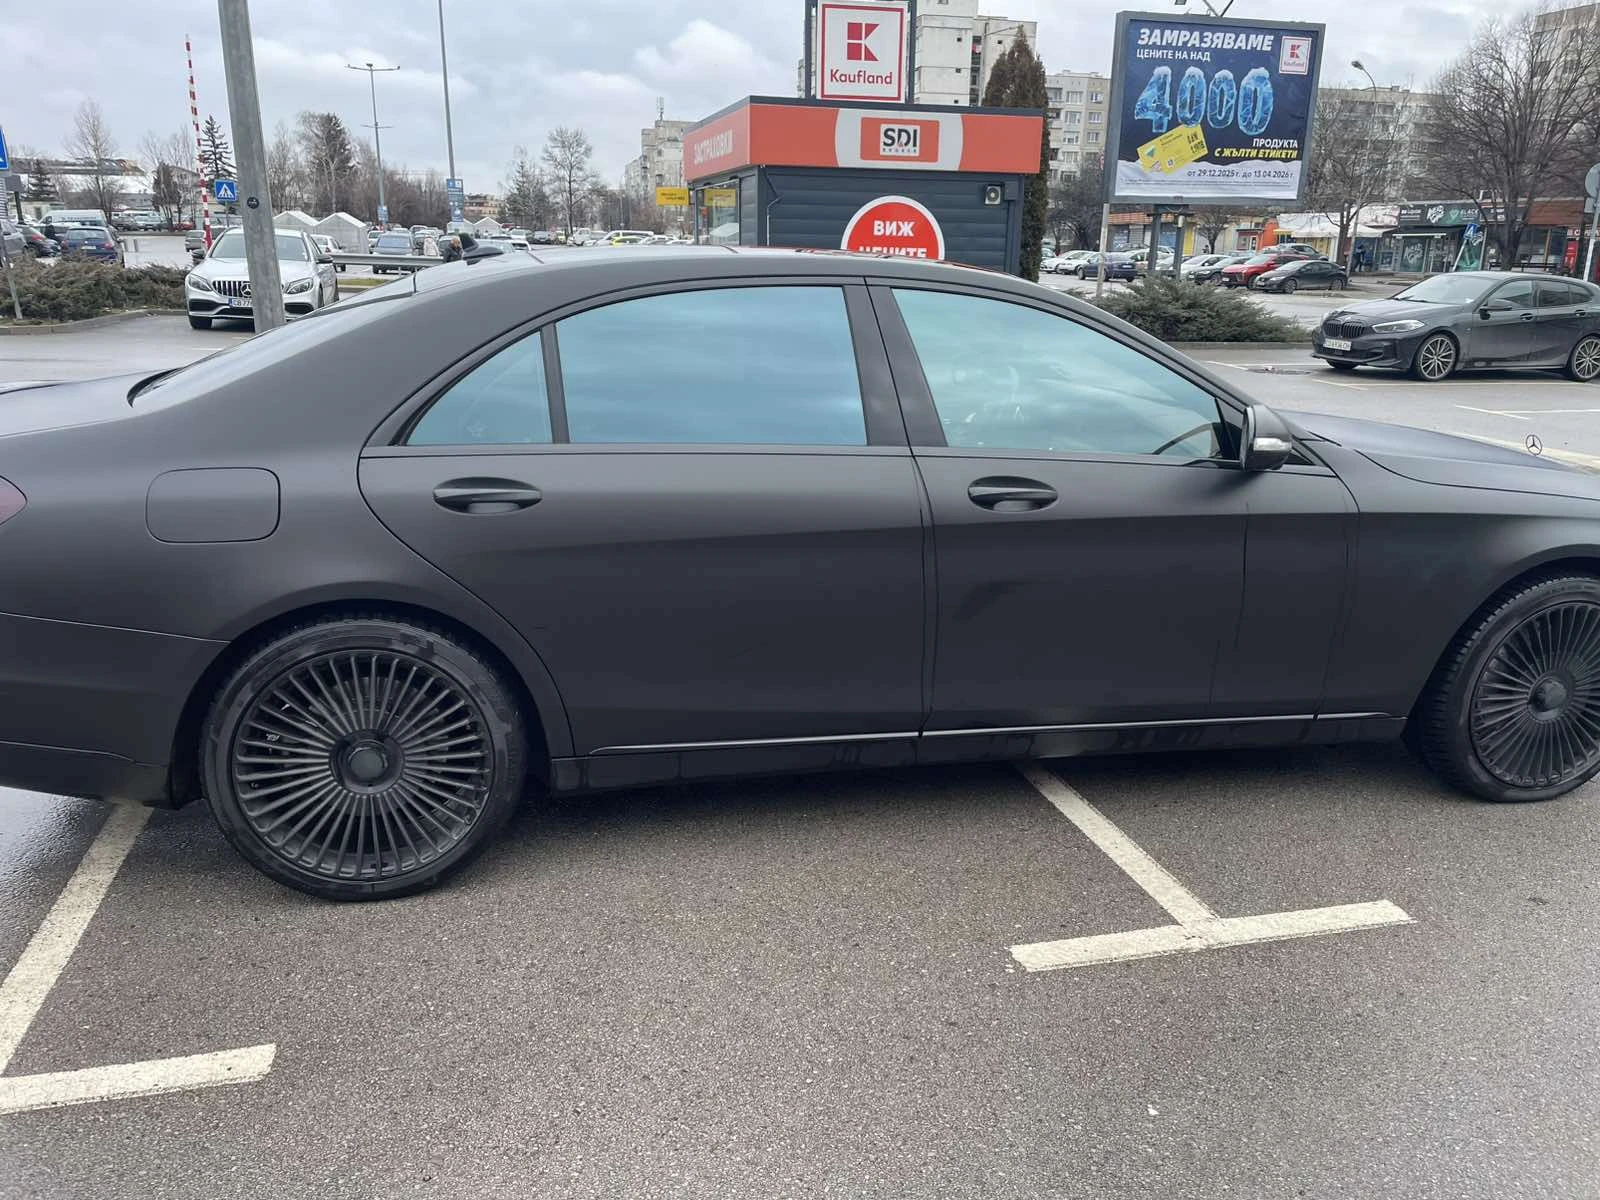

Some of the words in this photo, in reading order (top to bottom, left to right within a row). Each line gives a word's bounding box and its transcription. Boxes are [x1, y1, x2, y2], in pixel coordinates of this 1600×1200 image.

[1138, 28, 1274, 51] ЗАМРАЗЯВАМЕ
[1136, 49, 1173, 60] ЦЕНИТЕ
[1175, 50, 1188, 59] НА
[1190, 51, 1211, 62] НАД
[830, 69, 893, 85] Kaufland
[1134, 65, 1274, 136] 4000
[883, 127, 918, 148] SDI
[1253, 138, 1298, 149] ПРОДУКТА
[1222, 148, 1257, 158] ЖЪЛТИ
[1258, 149, 1298, 158] ЕТИКЕТИ
[1242, 171, 1252, 179] до
[873, 220, 915, 236] ВИЖ
